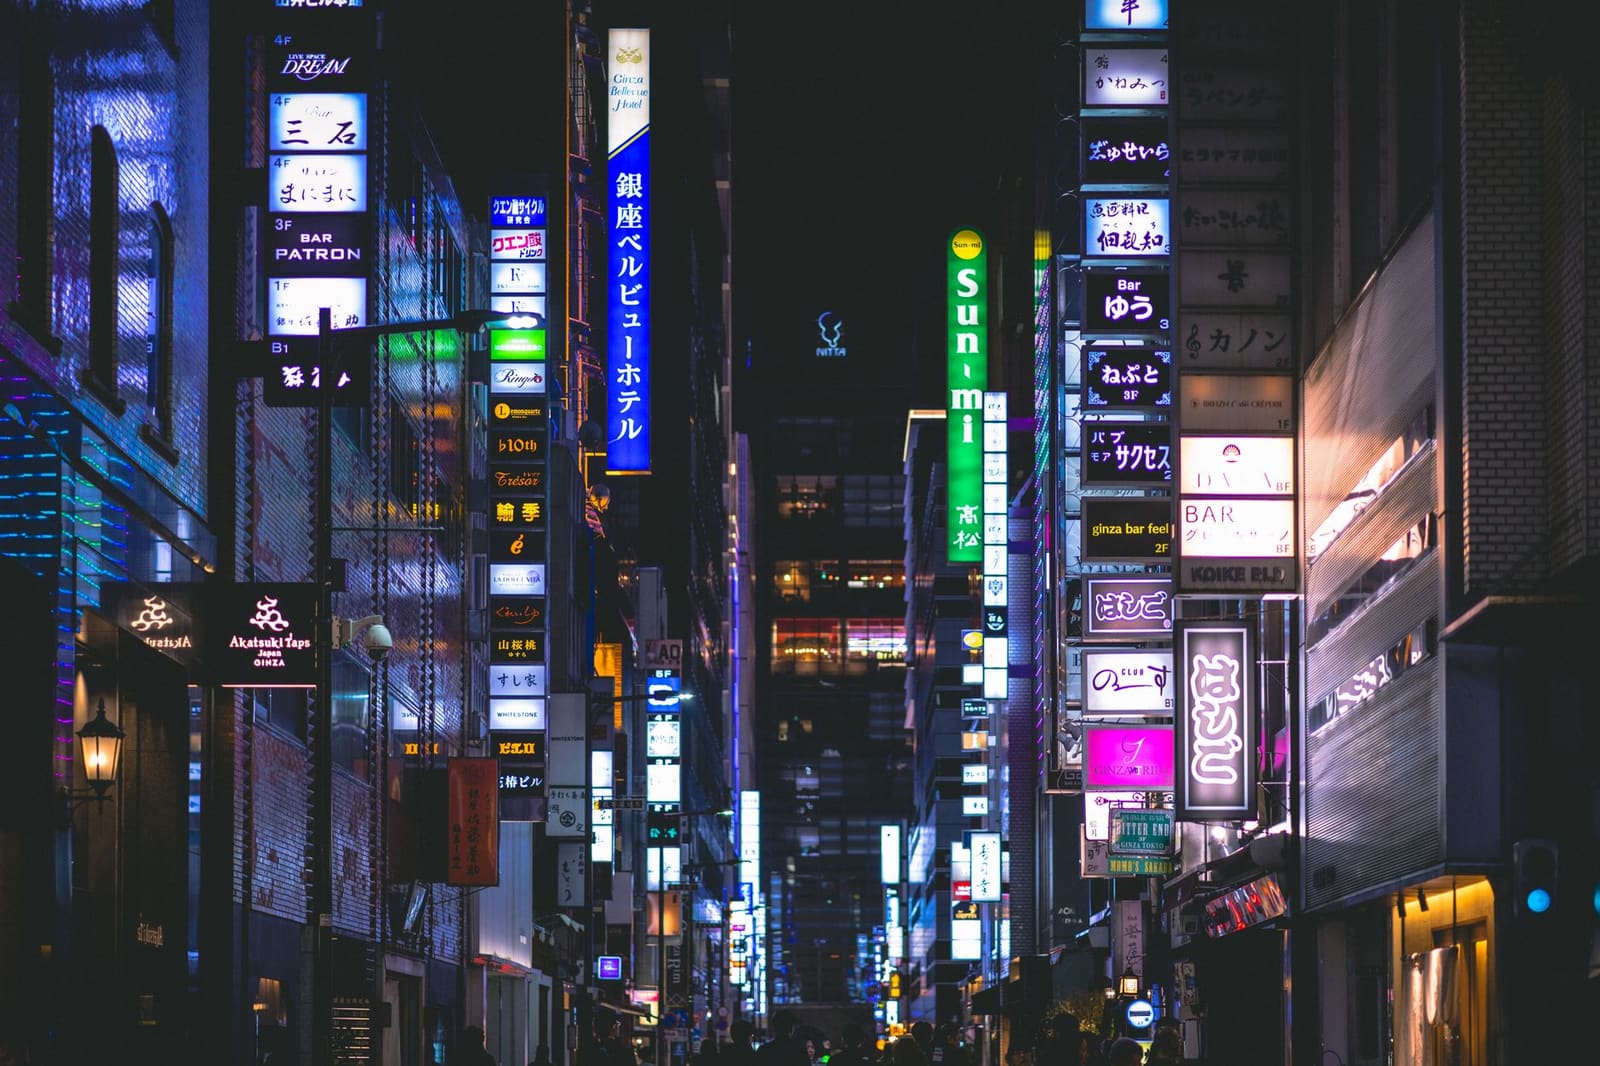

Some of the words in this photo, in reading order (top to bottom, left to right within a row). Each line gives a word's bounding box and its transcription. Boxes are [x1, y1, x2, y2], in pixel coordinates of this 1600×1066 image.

[274, 35, 291, 45] 4F
[281, 57, 351, 80] DREAM
[613, 73, 644, 85] Ginza
[610, 86, 648, 97] Bellevue
[274, 96, 291, 106] 4F
[274, 158, 291, 168] 4F
[280, 184, 356, 204] まにまに
[275, 219, 292, 230] 3F
[300, 233, 333, 243] BAR
[275, 248, 360, 260] PATRON
[274, 281, 289, 291] 1F
[1117, 279, 1141, 290] Bar
[616, 172, 643, 441] 銀座ベルビューホテル
[1105, 295, 1153, 320] ゆう
[1209, 328, 1287, 354] カノン
[271, 342, 288, 353] B1
[815, 347, 846, 357] NITTA
[951, 268, 982, 443] Sun-mi
[1123, 391, 1139, 400] 3F
[1277, 419, 1289, 429] 1F
[1091, 452, 1111, 462] モア
[1115, 445, 1171, 470] サクセス
[1276, 482, 1290, 491] BF
[1185, 505, 1234, 523] BAR
[1092, 523, 1122, 536] ginza
[1125, 523, 1145, 534] bar
[1147, 523, 1169, 534] feel
[1155, 543, 1169, 553] 2F
[1191, 566, 1246, 582] KOIKE
[230, 635, 283, 648] Akatsuki
[286, 632, 311, 649] Taps
[253, 659, 285, 667] GINZA
[1121, 668, 1144, 676] CLUB
[497, 672, 537, 687] すし家
[1116, 823, 1149, 836] BITTER
[1152, 824, 1170, 836] END
